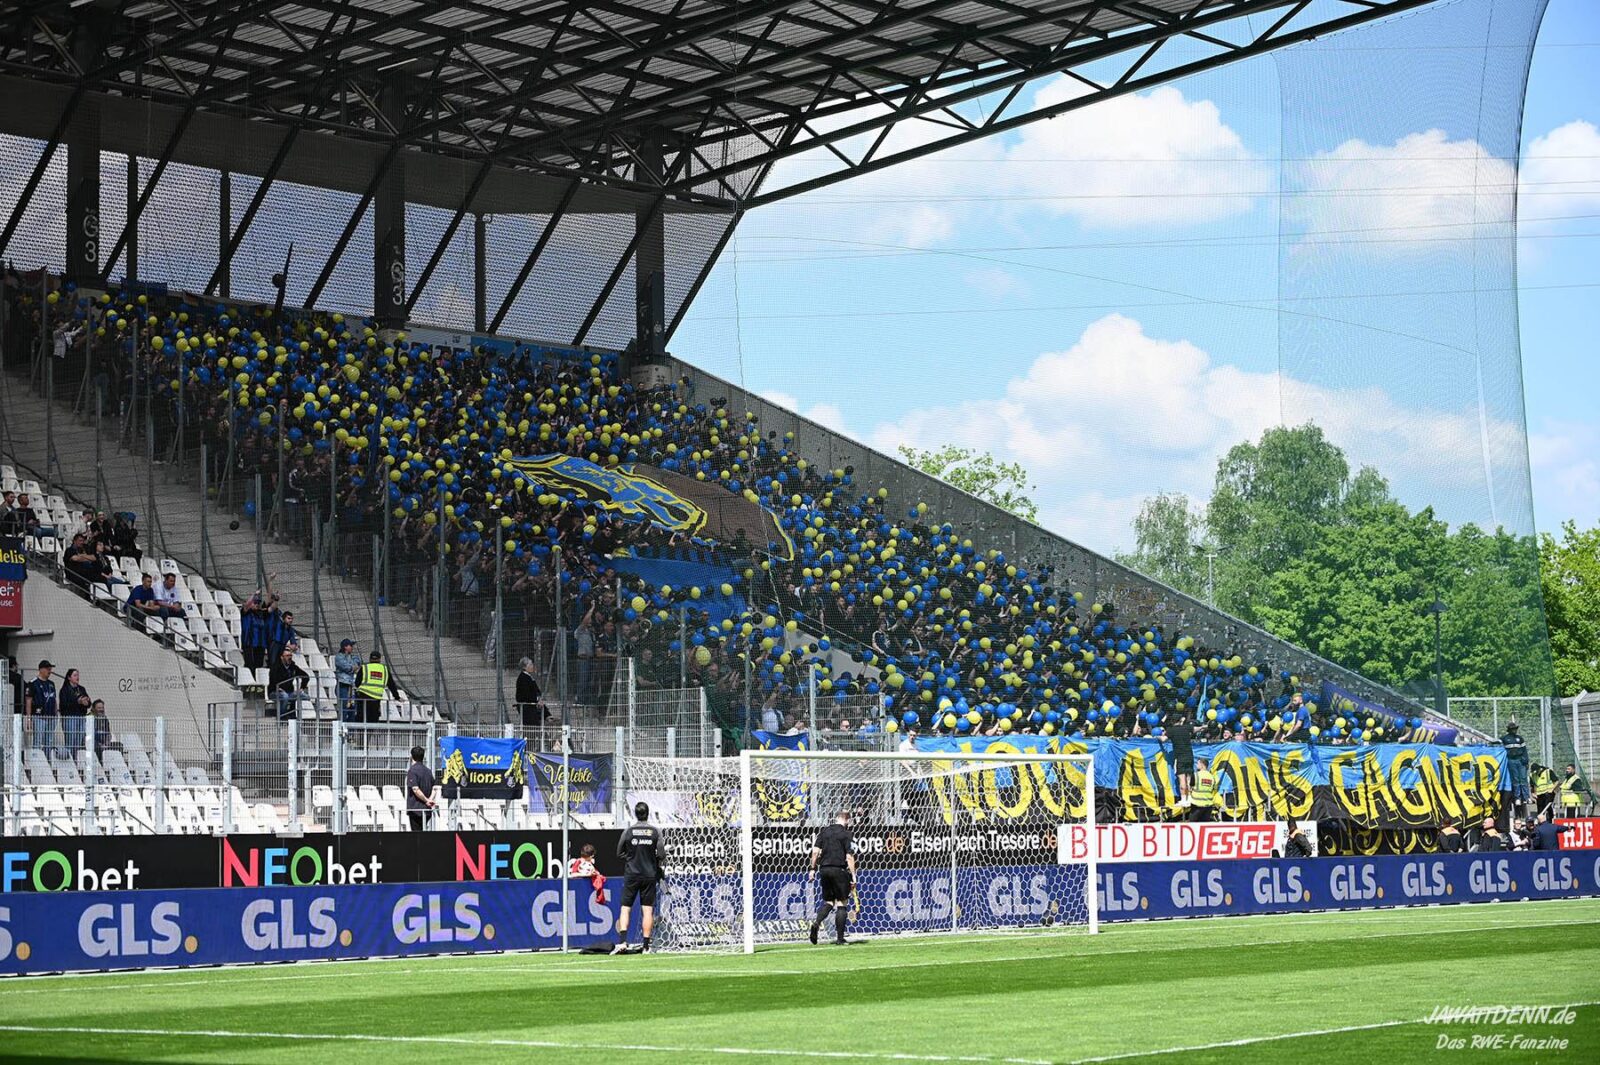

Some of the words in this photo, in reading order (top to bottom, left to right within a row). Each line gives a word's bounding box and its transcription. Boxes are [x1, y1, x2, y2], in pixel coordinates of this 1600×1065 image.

[118, 678, 133, 692] G2
[469, 752, 501, 765] Saar
[469, 771, 502, 784] lions
[1117, 747, 1314, 822] ALONS
[1329, 746, 1502, 826] GAGNER
[987, 829, 1057, 850] Tresore.de
[1143, 825, 1196, 857] BTD
[1563, 821, 1594, 848] HJE
